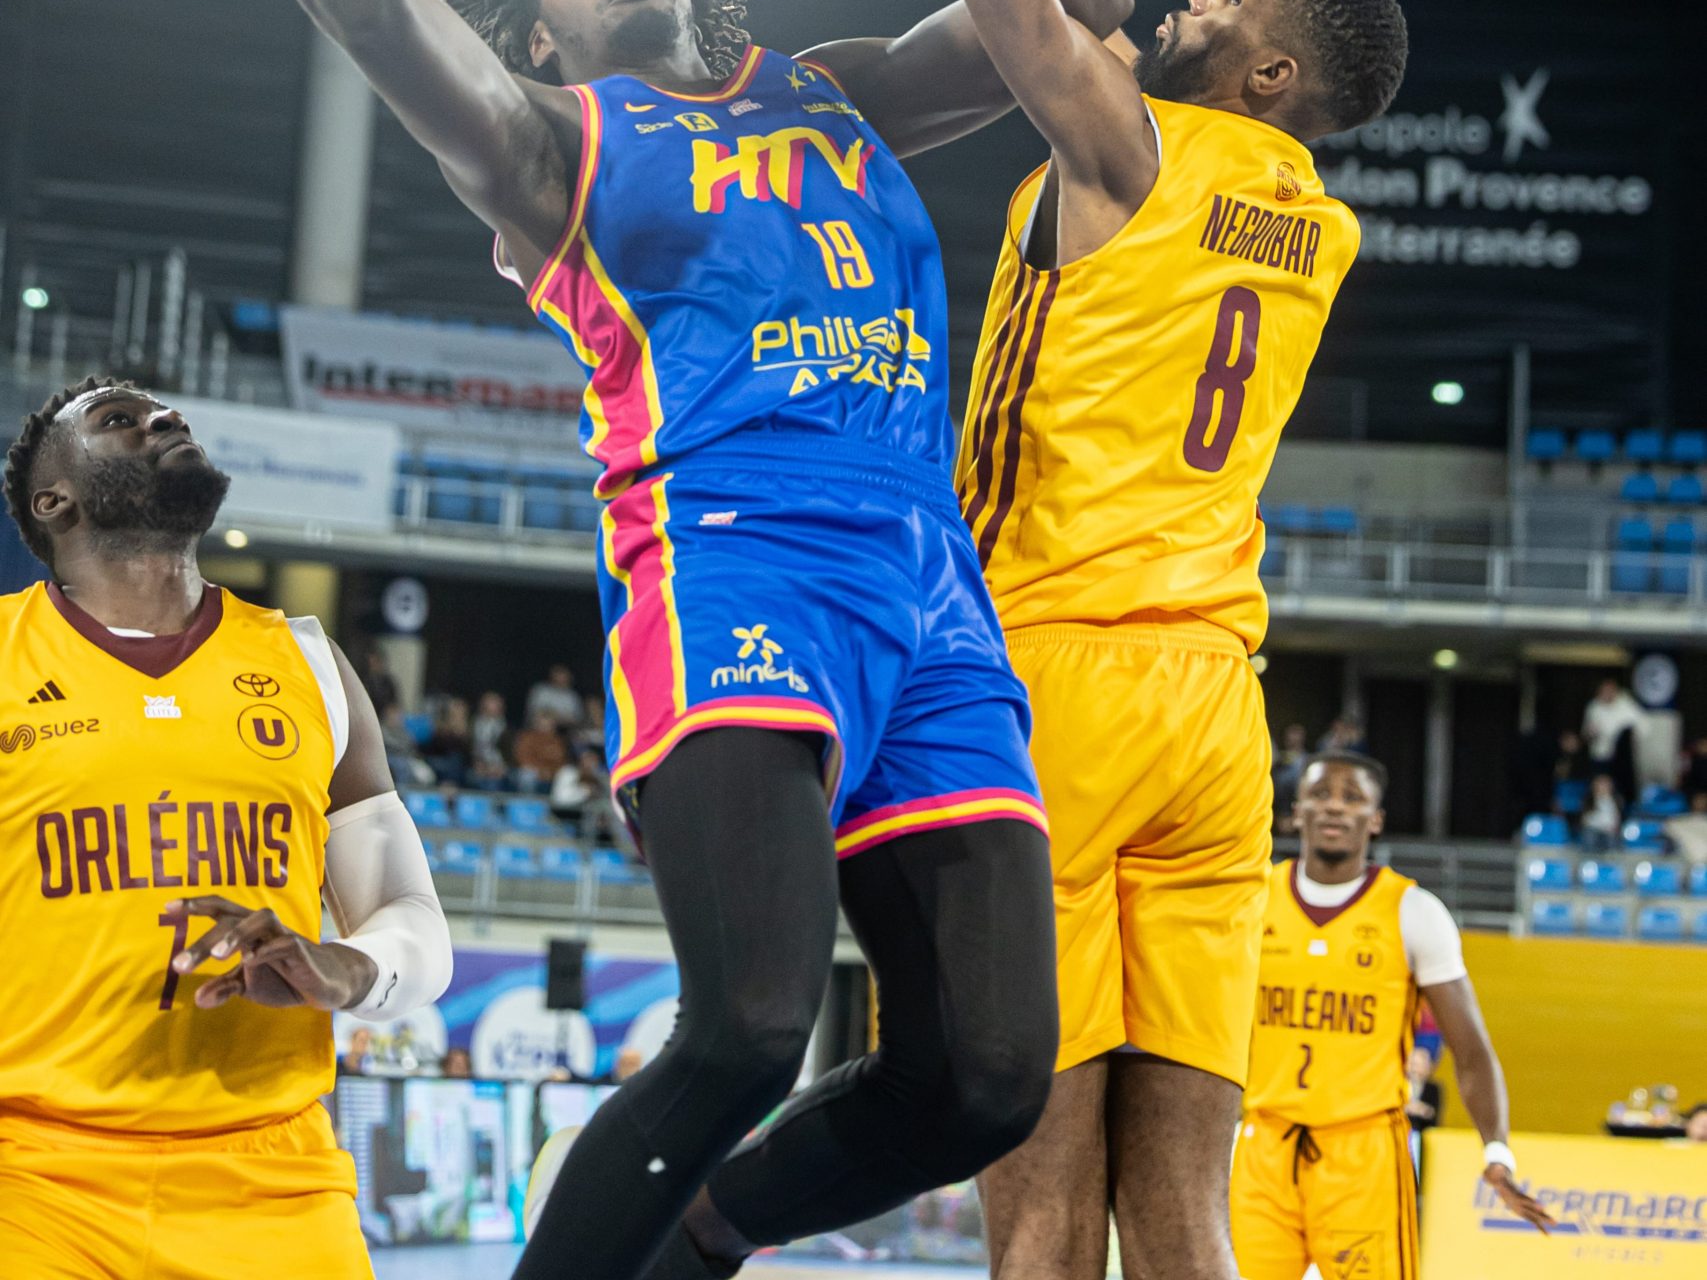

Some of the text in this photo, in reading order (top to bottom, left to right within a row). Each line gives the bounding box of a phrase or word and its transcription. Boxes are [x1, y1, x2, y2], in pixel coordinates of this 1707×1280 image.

[690, 127, 876, 214] HTV
[801, 220, 874, 290] 19
[1200, 194, 1321, 277] NEGROBAR
[1183, 285, 1261, 472] 8
[252, 717, 286, 747] U
[36, 790, 292, 899] ORLÉANS
[1297, 1042, 1313, 1090] 2
